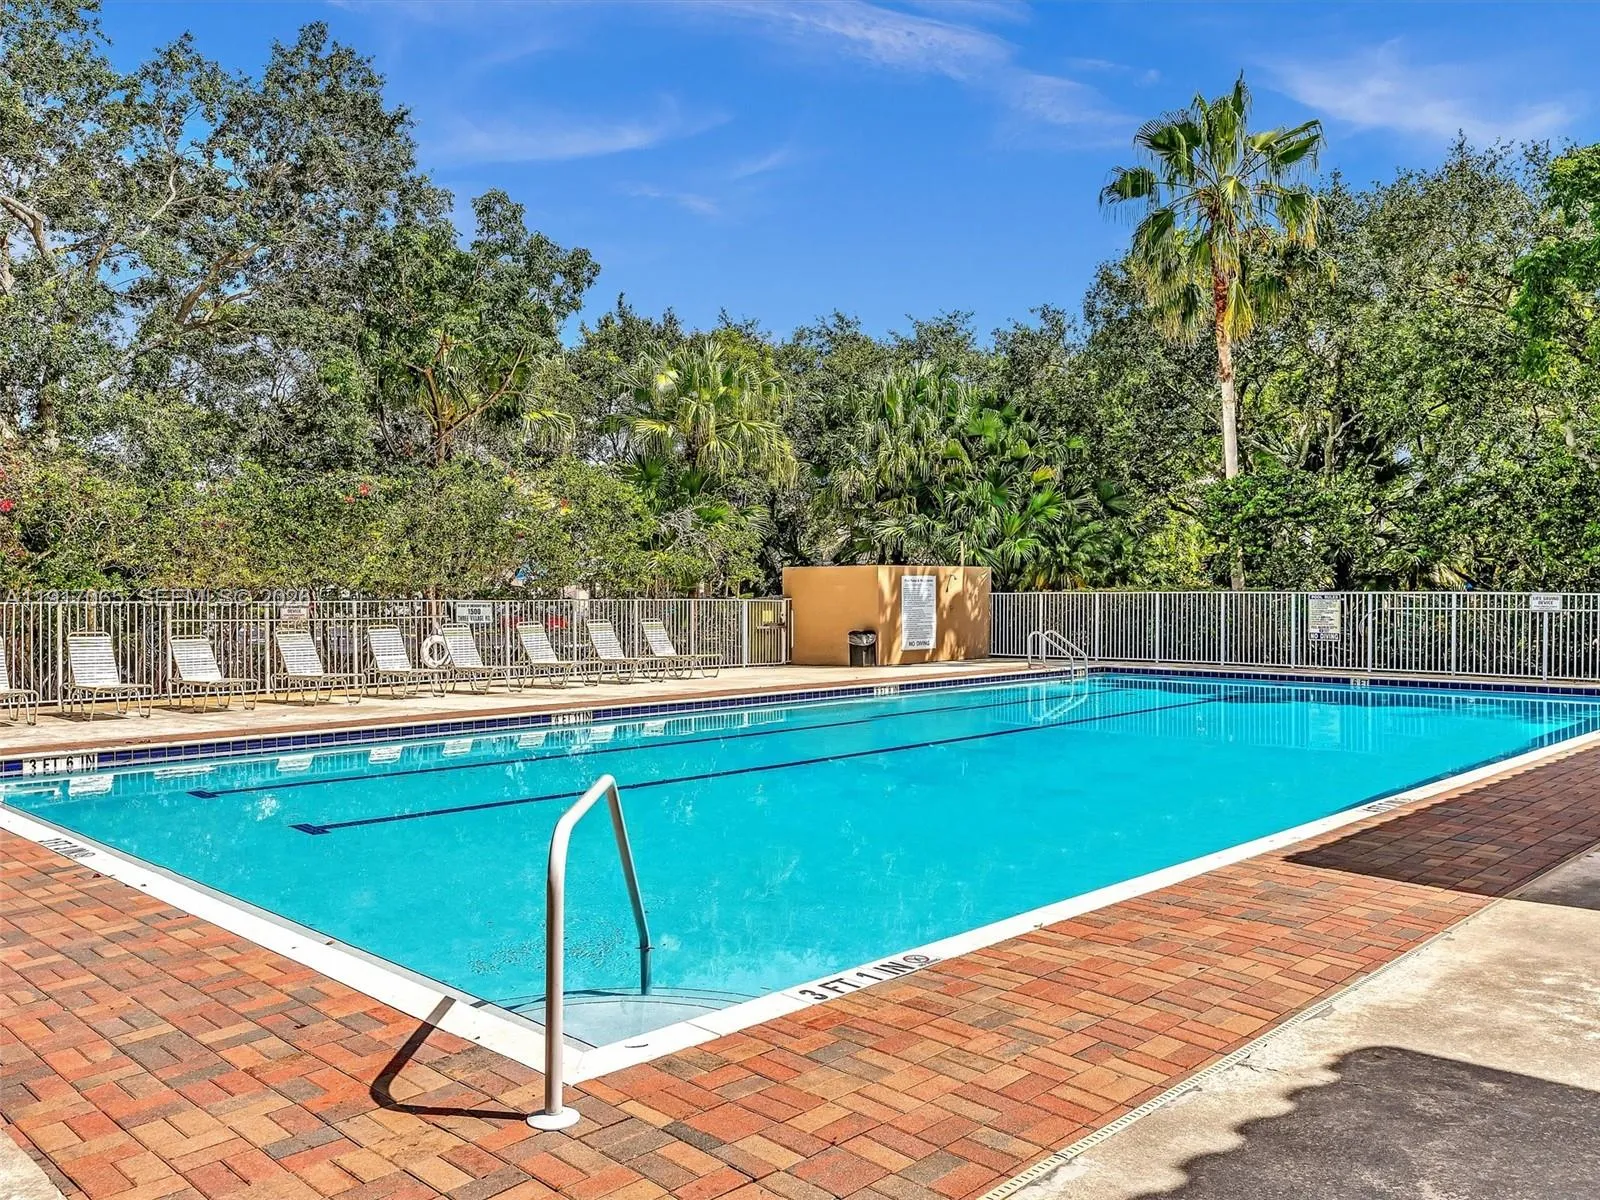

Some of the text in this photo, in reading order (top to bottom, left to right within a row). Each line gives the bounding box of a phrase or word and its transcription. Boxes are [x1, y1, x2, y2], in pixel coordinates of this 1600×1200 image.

[29, 759, 37, 777] 3
[66, 756, 74, 774] 6
[80, 754, 95, 773] IN
[799, 989, 829, 1000] 3
[818, 978, 860, 994] FT
[856, 972, 883, 981] 1
[873, 961, 915, 976] IN
